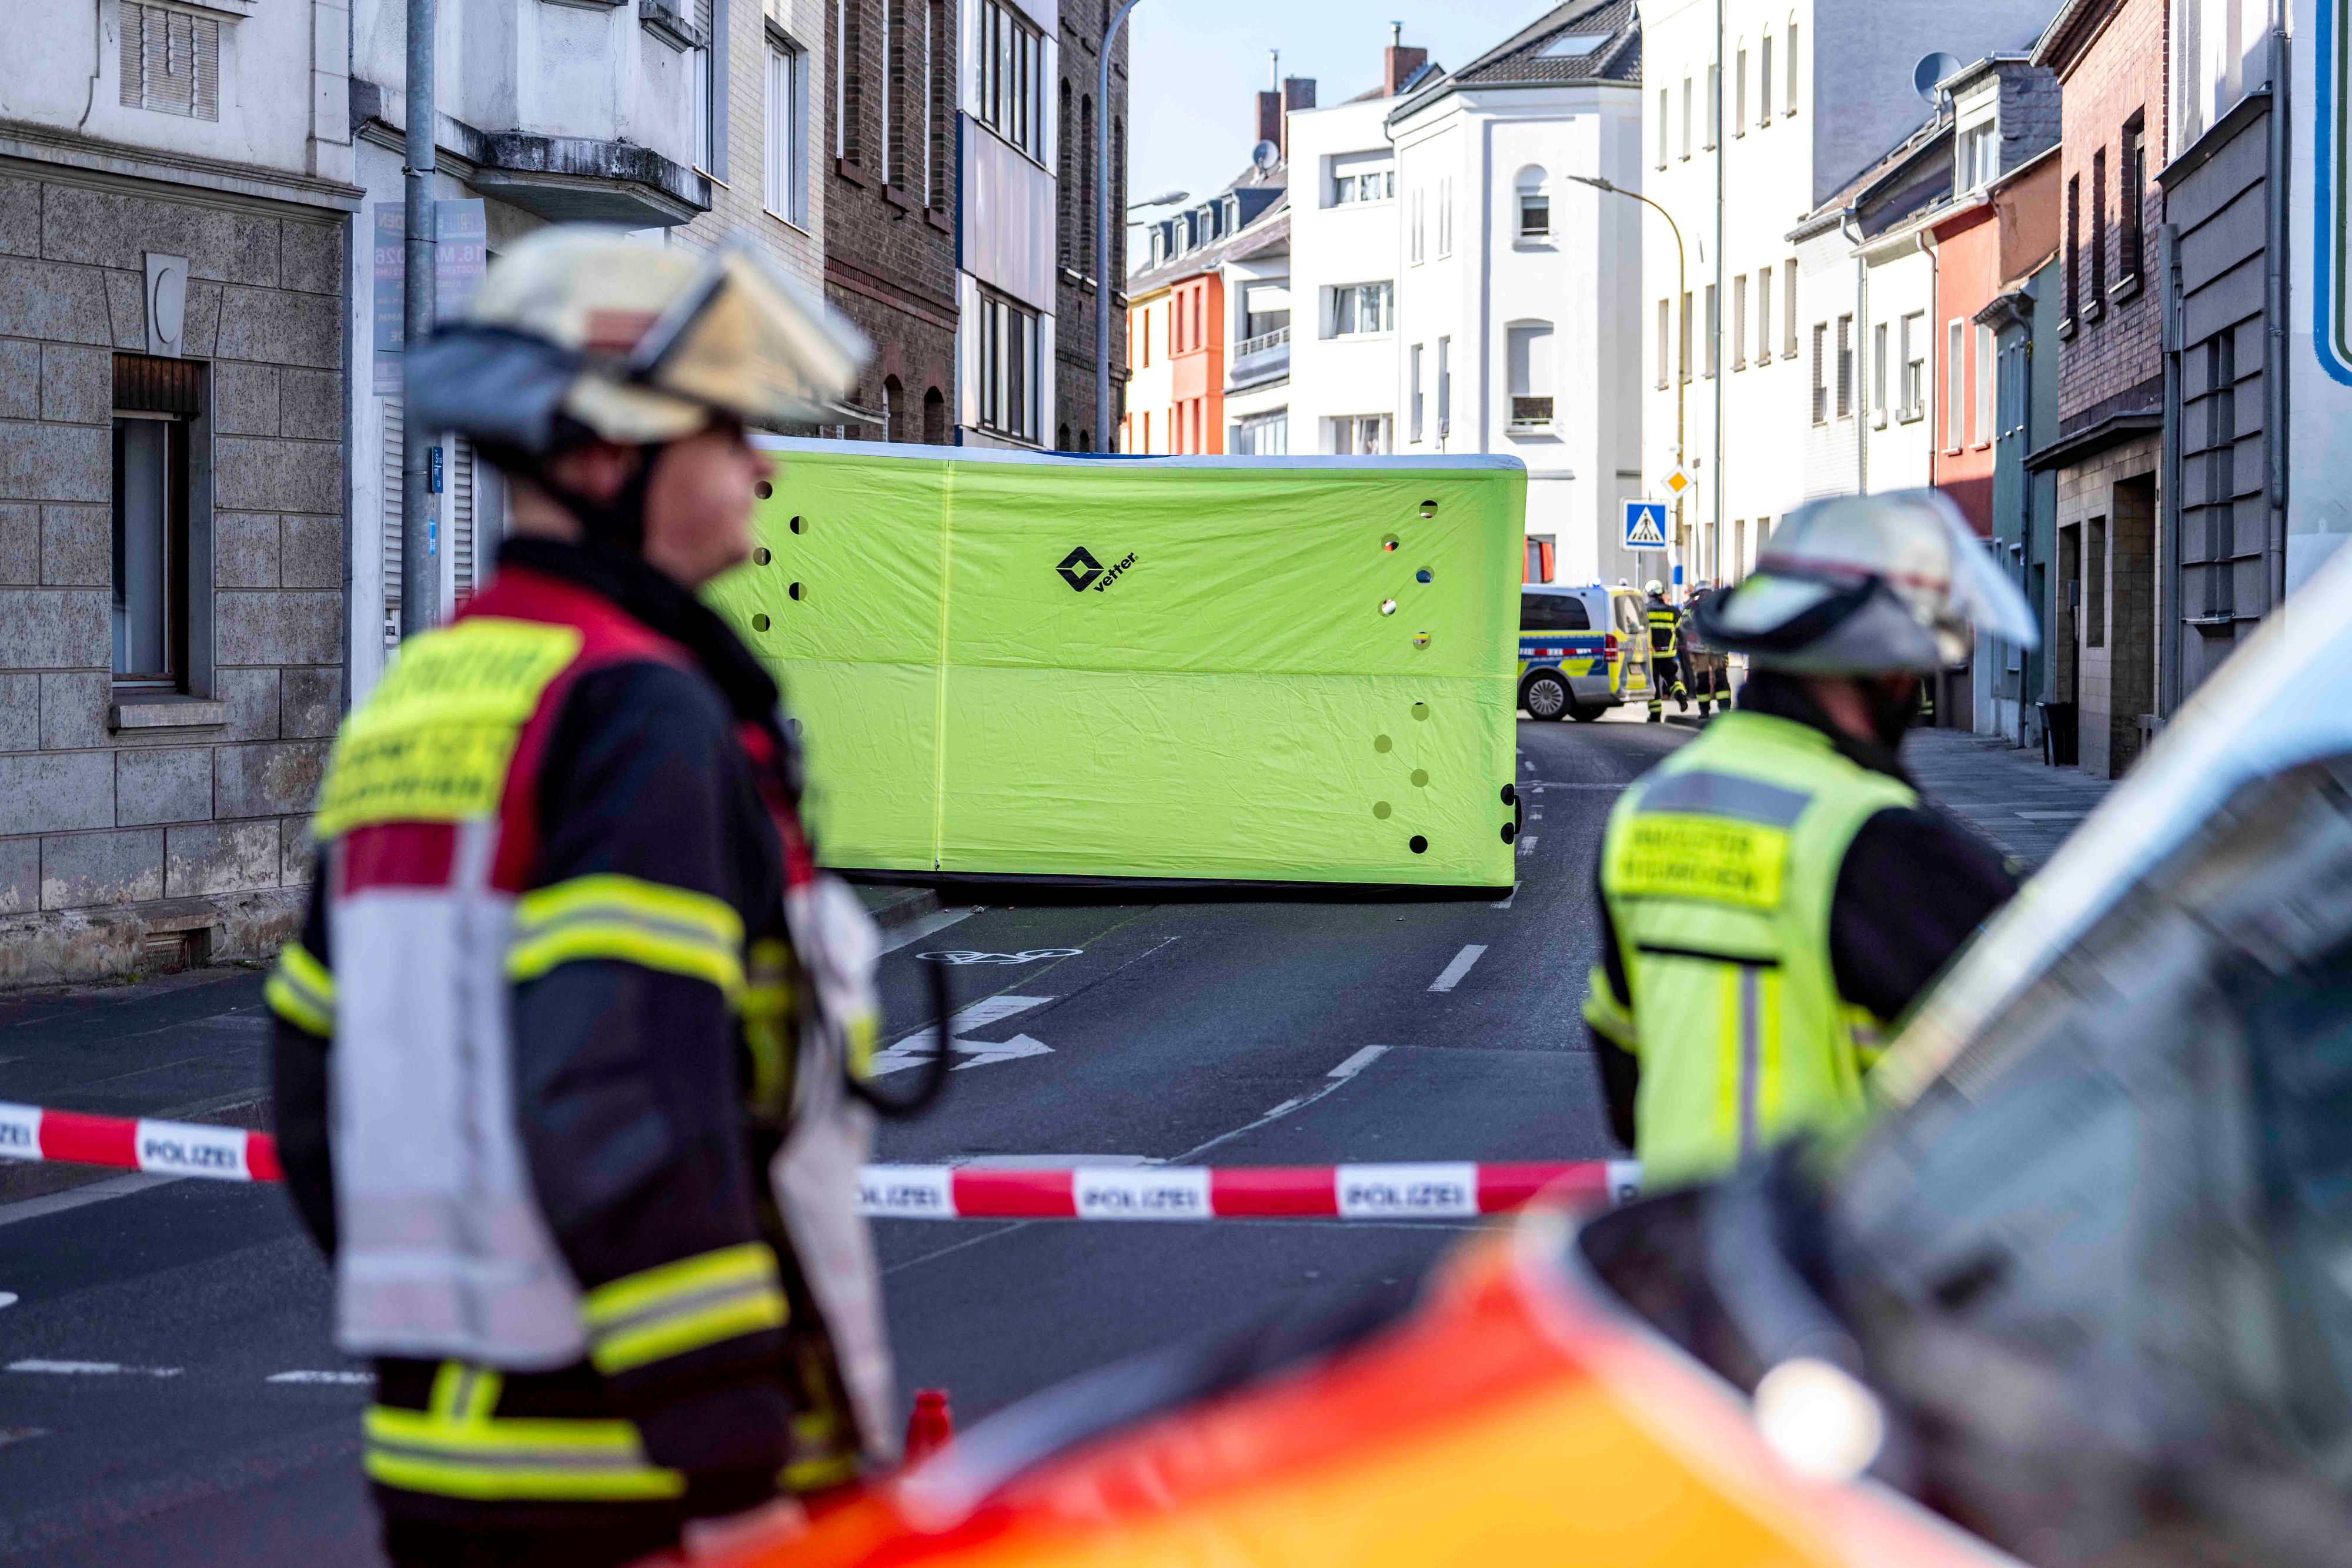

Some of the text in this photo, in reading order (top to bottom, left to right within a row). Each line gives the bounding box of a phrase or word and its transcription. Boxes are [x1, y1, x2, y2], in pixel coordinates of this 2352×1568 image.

[1093, 551, 1136, 593] vetter
[145, 1138, 238, 1168] POLIZEI
[1085, 1188, 1198, 1207] POLIZEI
[1348, 1184, 1464, 1205] POLIZEI
